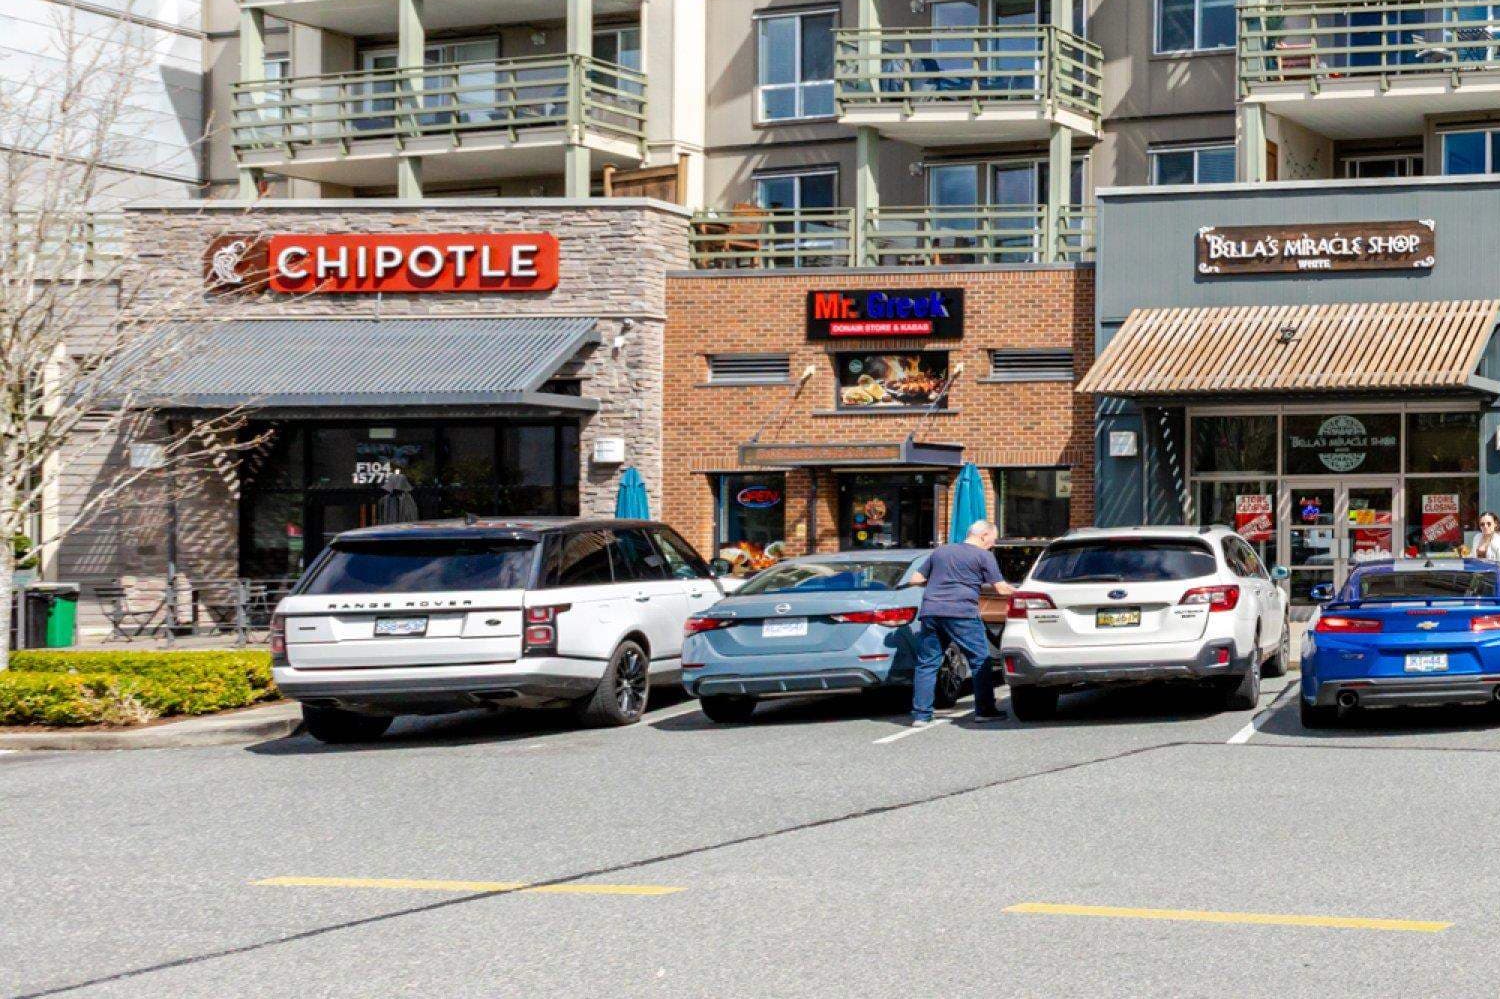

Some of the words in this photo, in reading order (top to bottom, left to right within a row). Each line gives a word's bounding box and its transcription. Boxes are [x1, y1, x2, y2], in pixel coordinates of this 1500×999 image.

[1206, 233, 1279, 258] BELLA'S
[1283, 232, 1362, 256] MIRACLE
[1367, 234, 1420, 253] SHOP
[277, 245, 538, 278] CHIPOTLE
[1298, 259, 1331, 269] WHITE
[815, 291, 858, 319] Mr.
[867, 291, 949, 318] Greek
[356, 461, 391, 473] F104
[406, 599, 472, 607] ROVER
